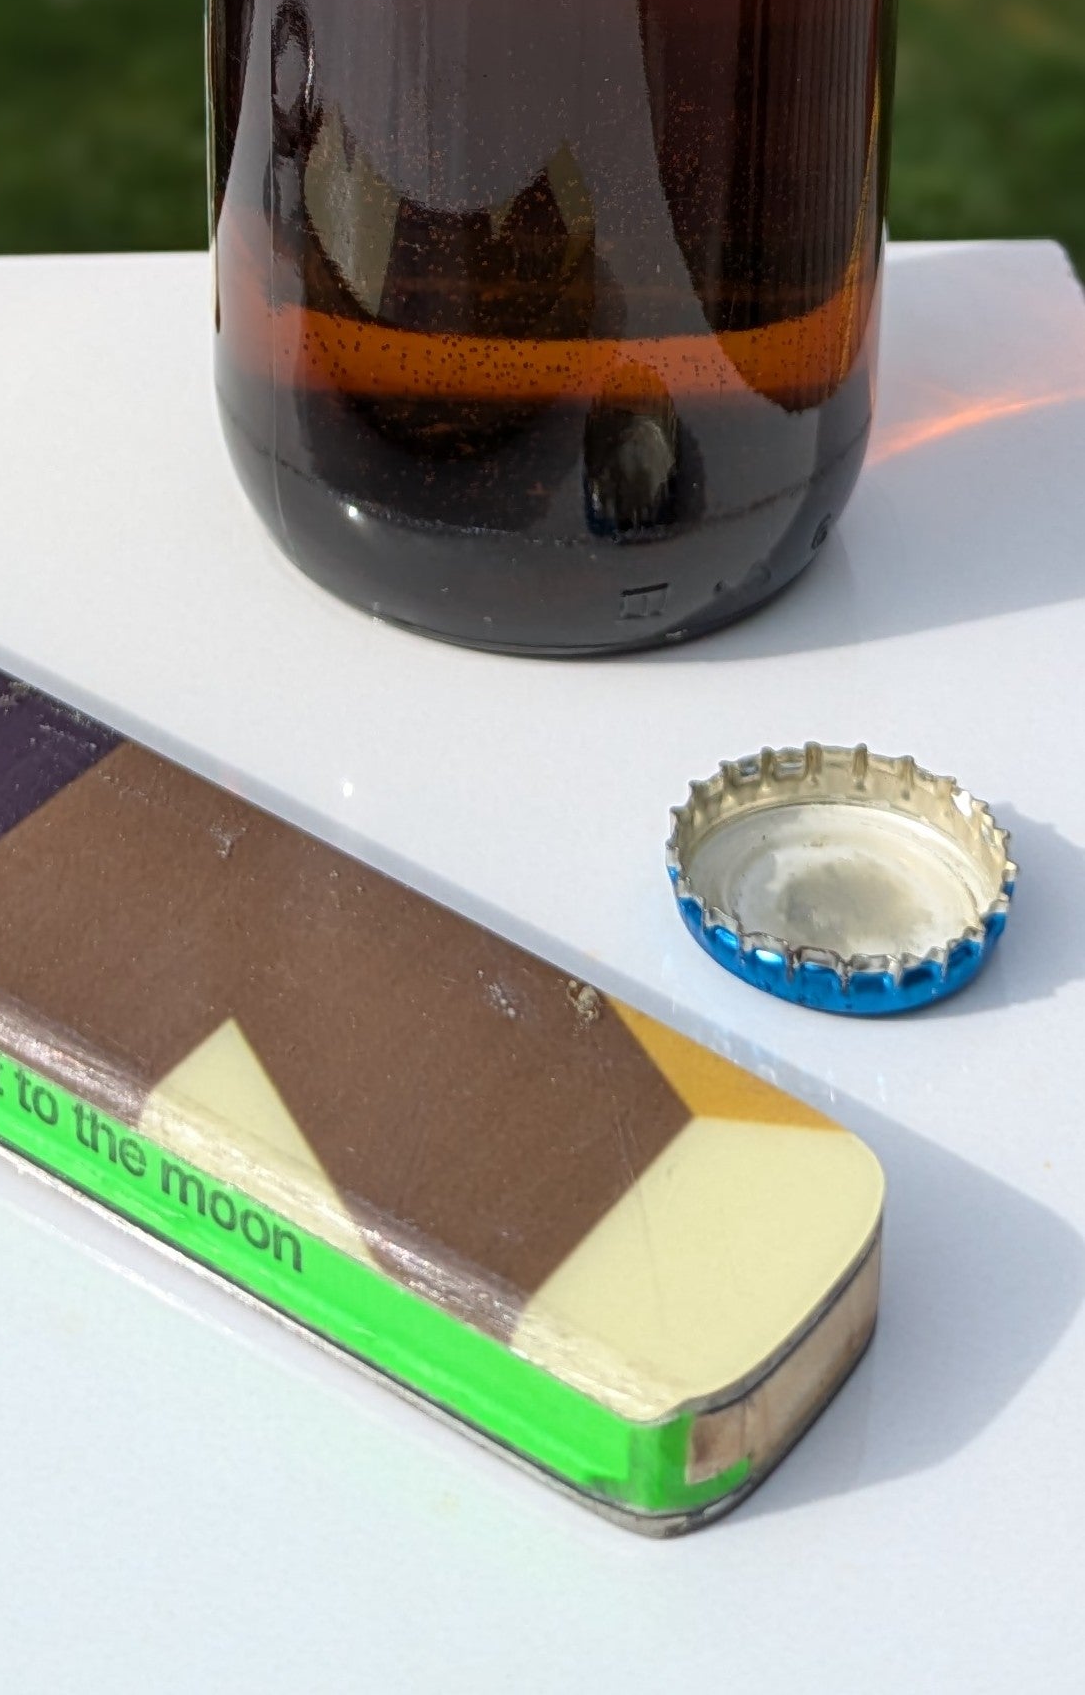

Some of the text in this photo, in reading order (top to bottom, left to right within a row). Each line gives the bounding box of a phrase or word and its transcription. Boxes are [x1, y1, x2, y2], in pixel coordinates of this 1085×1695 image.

[15, 1067, 59, 1125] to
[71, 1103, 146, 1177] the
[161, 1158, 302, 1273] moon
